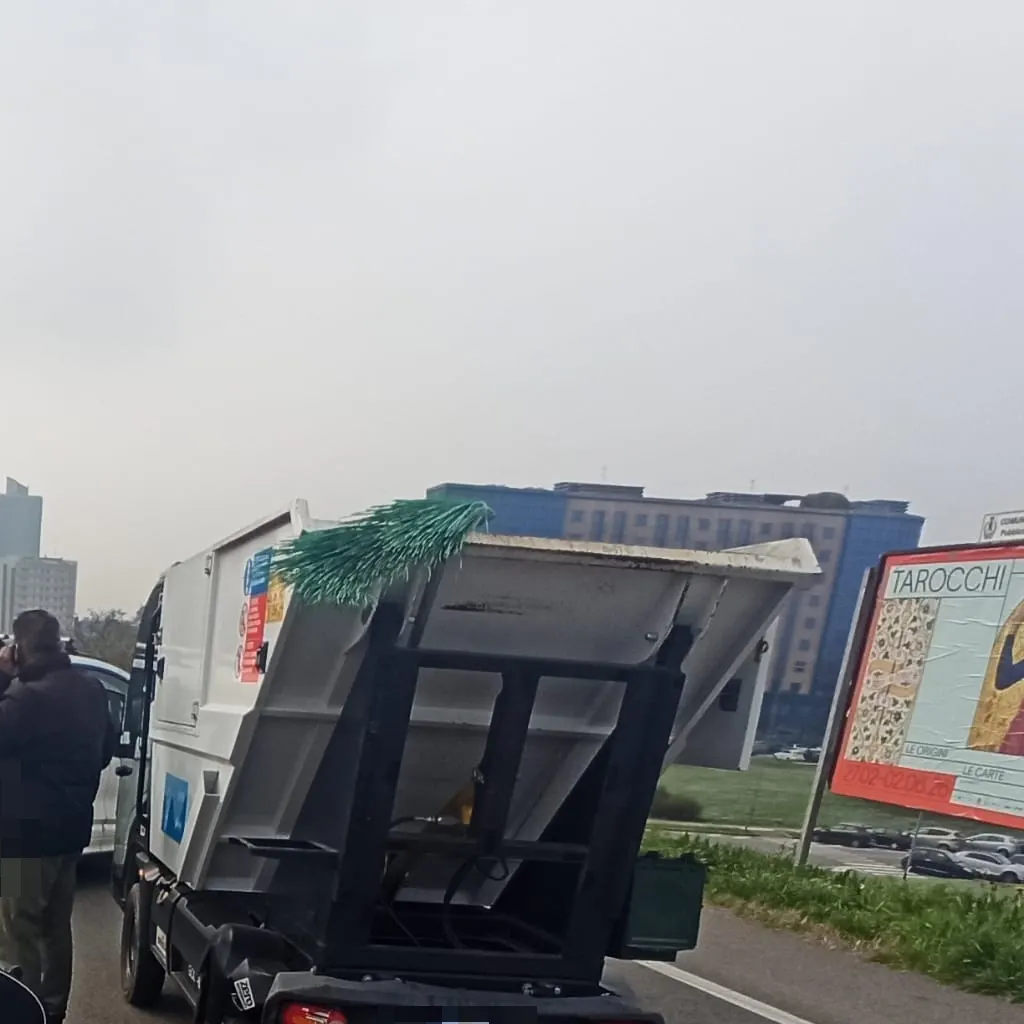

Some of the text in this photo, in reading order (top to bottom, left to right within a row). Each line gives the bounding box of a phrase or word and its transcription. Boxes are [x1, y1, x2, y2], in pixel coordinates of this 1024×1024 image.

[893, 565, 1008, 594] TAROCCHI
[905, 743, 915, 754] LE
[962, 765, 1006, 781] LE CARTE
